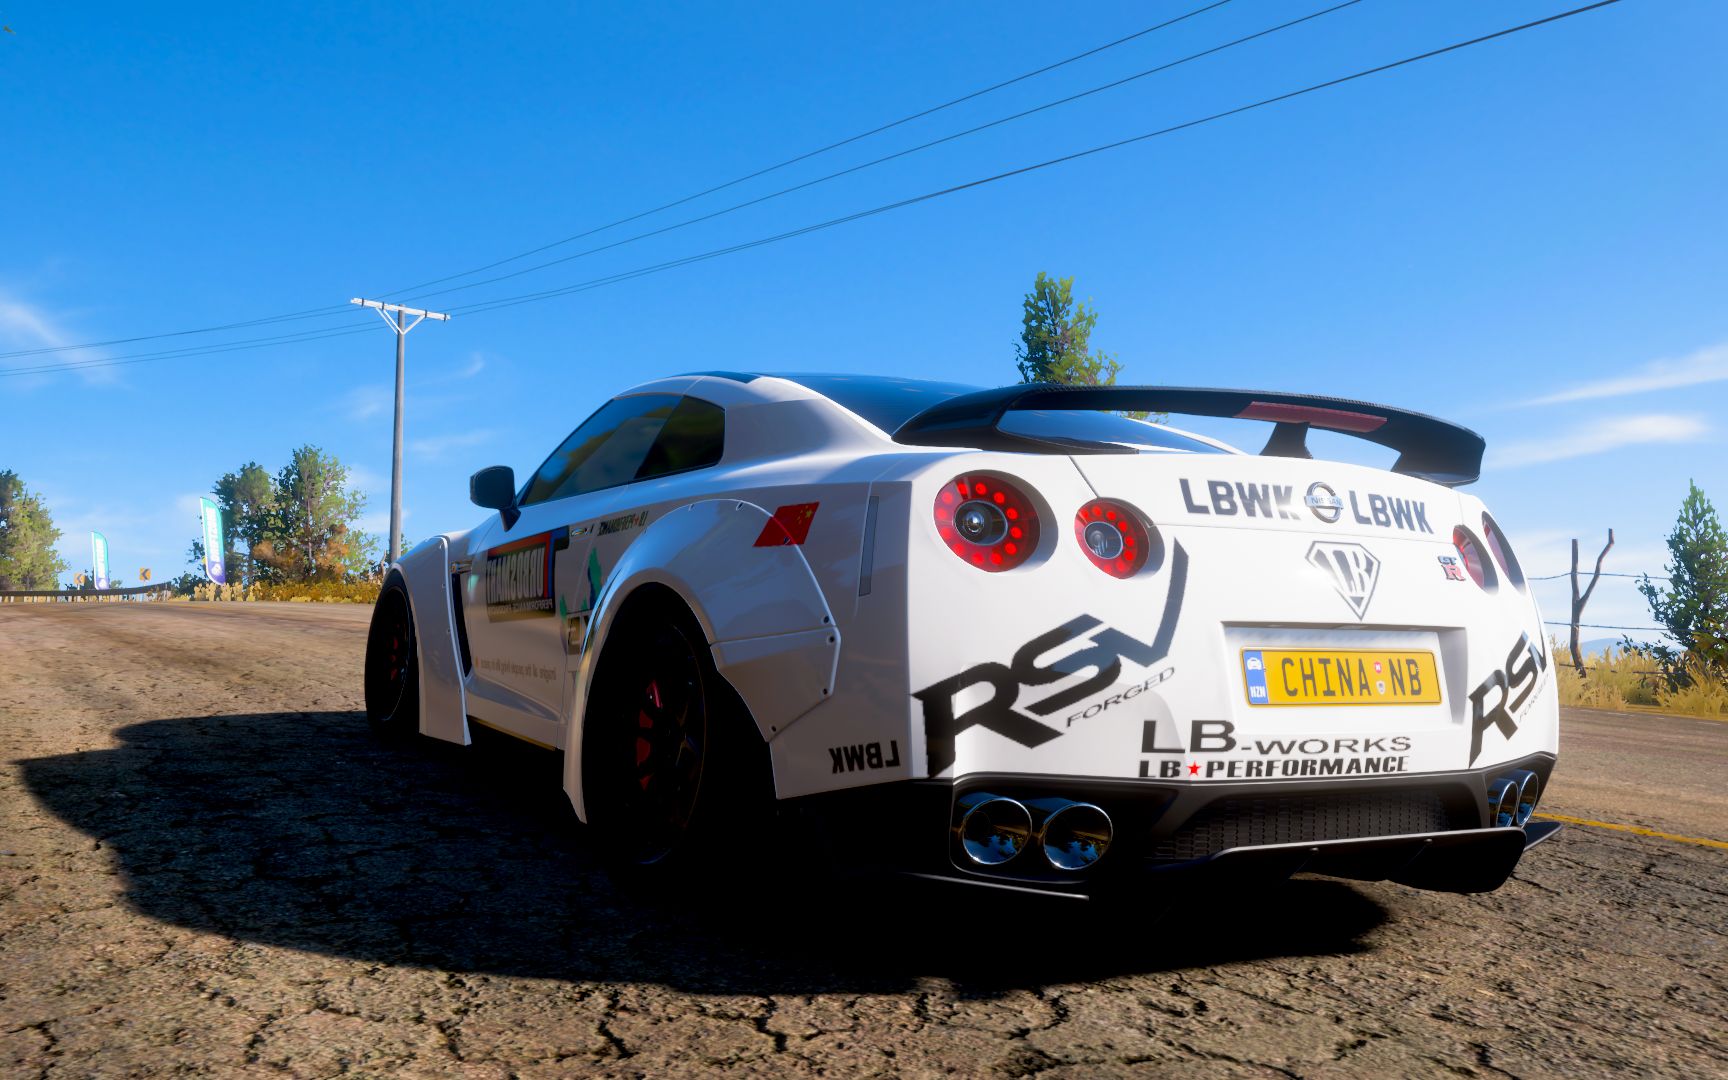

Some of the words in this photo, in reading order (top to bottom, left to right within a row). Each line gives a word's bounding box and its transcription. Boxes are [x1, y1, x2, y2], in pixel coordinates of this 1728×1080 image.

[1179, 478, 1301, 520] LBWK
[1349, 490, 1434, 534] LBWK
[1066, 666, 1175, 727] FORGED
[1281, 657, 1372, 697] CHINA
[1388, 658, 1422, 696] NB
[1142, 720, 1411, 755] LB-WORKS
[1206, 756, 1408, 778] PERFORMANCE
